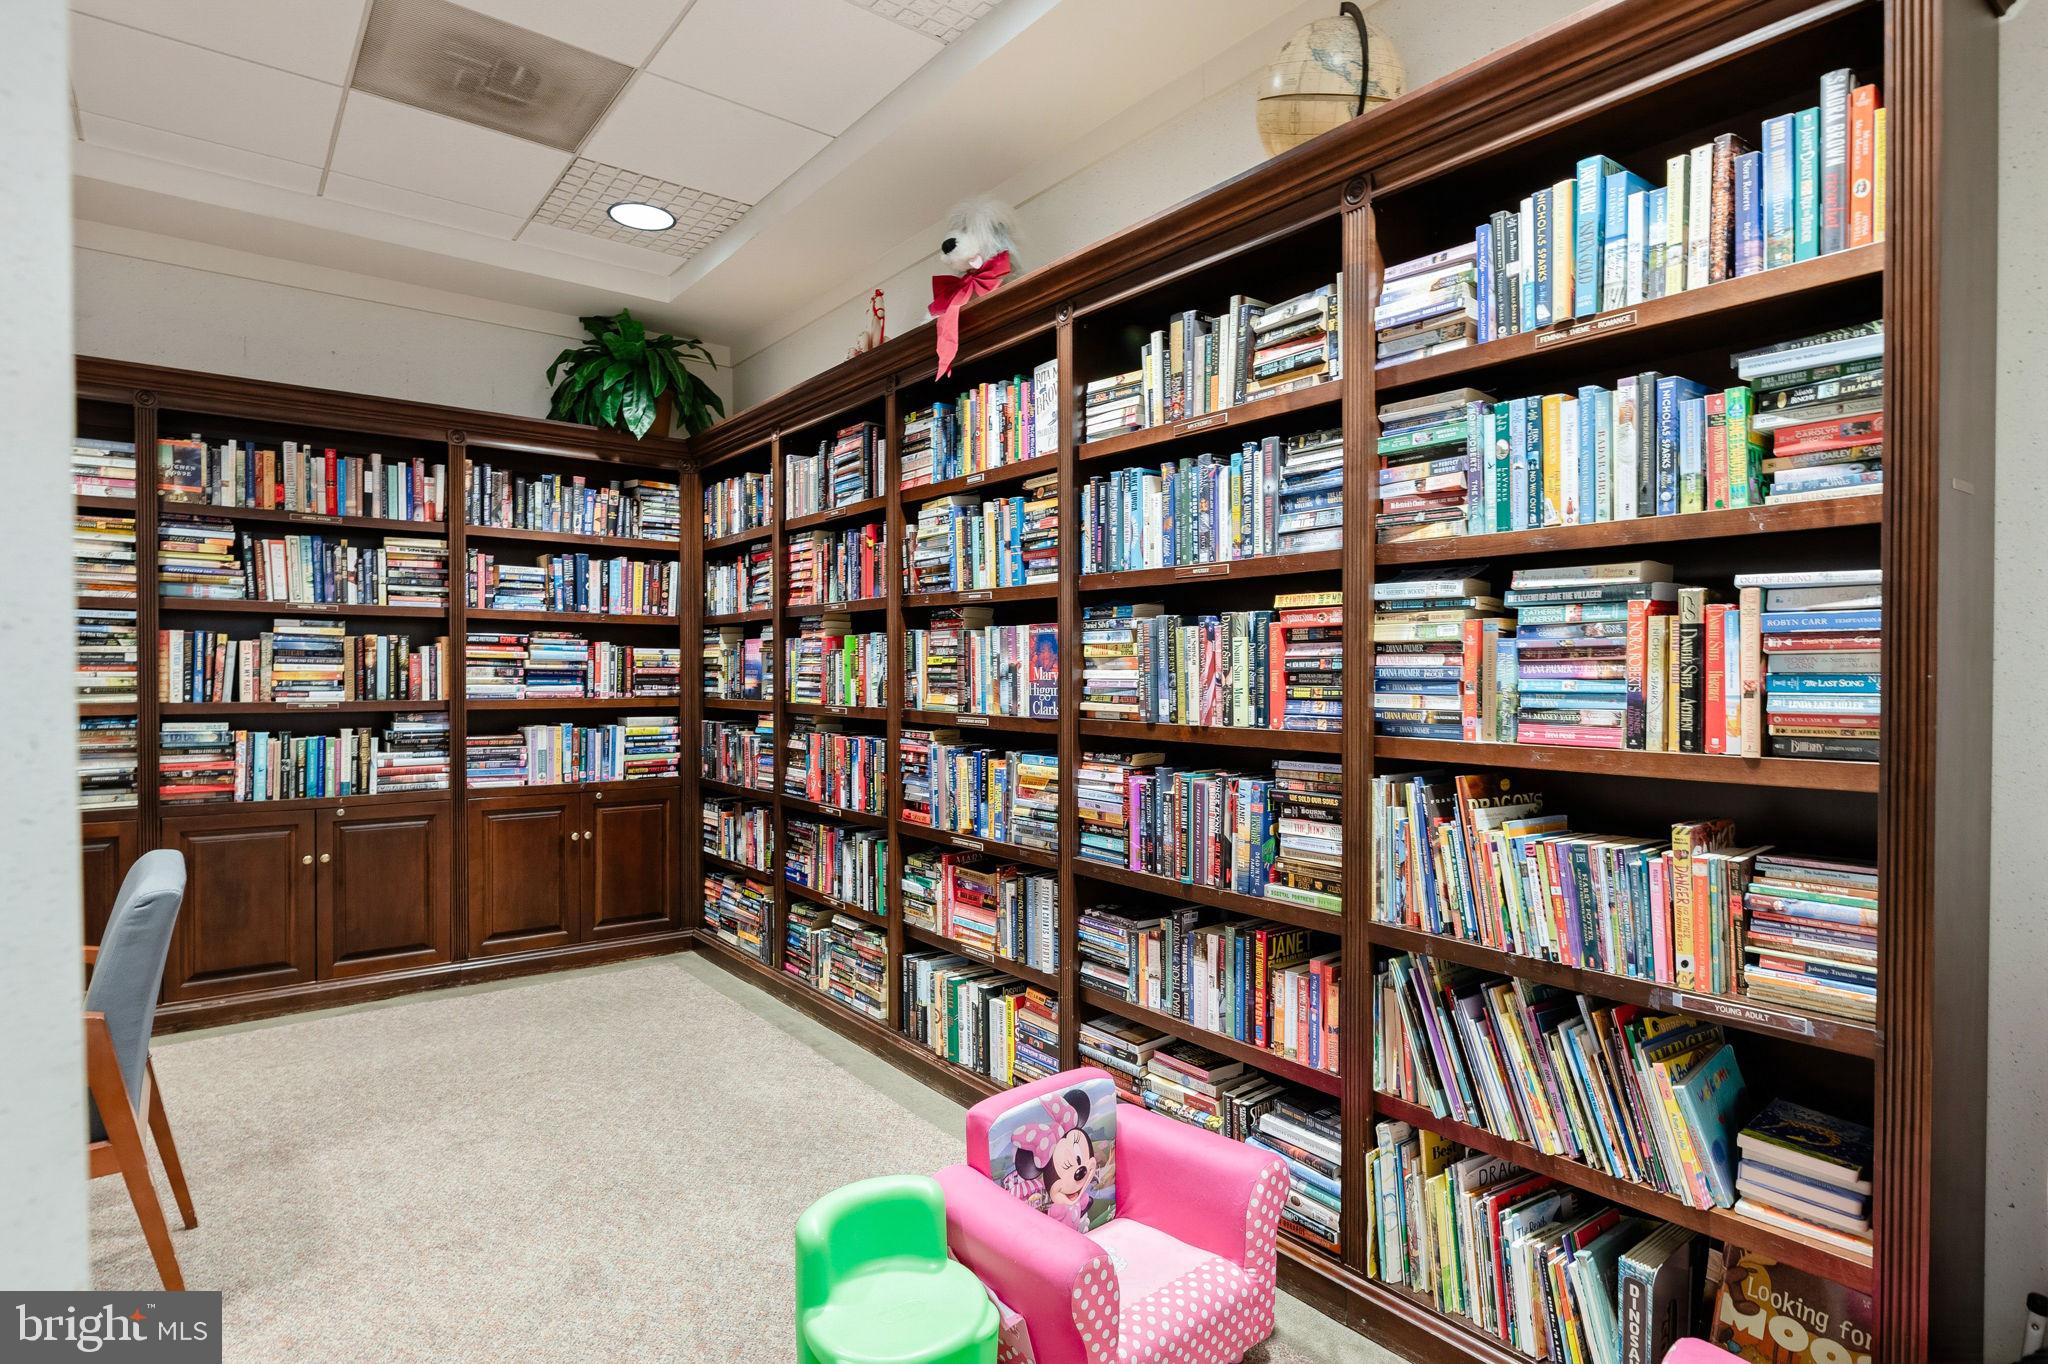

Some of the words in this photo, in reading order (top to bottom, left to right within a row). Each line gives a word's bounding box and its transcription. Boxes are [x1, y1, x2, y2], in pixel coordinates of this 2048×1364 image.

[1826, 75, 1845, 122] SANDRA
[1770, 121, 1788, 147] NORA
[1826, 124, 1845, 167] BROWN
[1743, 160, 1751, 179] Nora
[1743, 181, 1752, 210] Roberts
[1826, 173, 1845, 228] ricochet
[1536, 193, 1547, 246] NICHOLAS
[1772, 194, 1787, 237] HIDEAWAY
[1538, 249, 1547, 282] SPARKS
[1578, 253, 1594, 284] GOLD
[1598, 315, 1632, 328] ROMANCE
[1830, 332, 1851, 342] SEE
[1852, 328, 1866, 337] US
[1036, 372, 1050, 390] RITA
[1841, 383, 1869, 393] LILAC
[1662, 390, 1671, 435] NICHOLAS
[1795, 426, 1839, 439] CAROLYN
[1244, 448, 1252, 461] TONY
[1598, 432, 1606, 468] RADAR
[1661, 439, 1670, 468] SPARKS
[1821, 450, 1850, 460] DAILEY
[1244, 463, 1252, 495] HILLERMAN
[1530, 471, 1536, 482] NO
[1598, 472, 1606, 505] GIRLS
[1539, 592, 1546, 600] OF
[1547, 592, 1561, 600] DAVE
[1562, 591, 1573, 600] THE
[1574, 591, 1602, 599] VILLAGER
[1523, 615, 1564, 623] ANDERSON
[1708, 608, 1723, 641] DANIELLE
[1222, 615, 1230, 649] DANIELLE
[1629, 621, 1642, 650] NORA
[1403, 644, 1423, 652] PALMER
[1652, 628, 1660, 673] NICHOLAS
[1680, 629, 1697, 665] DANIELLE
[1708, 642, 1724, 662] STEEL
[1034, 667, 1058, 681] Mary
[1222, 651, 1231, 672] STEEL
[1380, 669, 1398, 677] DIANA
[1400, 669, 1420, 677] PALMER
[1628, 653, 1641, 692] ROBERTS
[1680, 665, 1697, 689] STEEL
[1032, 701, 1058, 715] Clark
[1385, 712, 1401, 720] DIANA
[1402, 712, 1421, 720] PALMER
[1681, 698, 1696, 732] ACCIDENT
[1834, 701, 1864, 709] MILLER
[1301, 808, 1326, 816] BOURNE
[1312, 796, 1321, 804] OUR
[1323, 798, 1338, 806] SOULS
[1271, 890, 1289, 898] DIGITAL
[1292, 893, 1314, 903] FORTRESS
[1582, 874, 1591, 906] HARRY
[1675, 865, 1690, 905] DANGER
[1271, 931, 1312, 960] JANET
[1807, 965, 1828, 976] Johnny
[1832, 969, 1858, 979] Tremain
[1715, 1004, 1742, 1016] YOUNG
[1745, 1010, 1769, 1022] ADULT
[1256, 1026, 1263, 1040] UP
[1551, 1092, 1561, 1113] STORIES
[1629, 1284, 1640, 1364] DINOSA
[1747, 1276, 1829, 1332] Looking
[1839, 1323, 1872, 1350] for
[1720, 1292, 1872, 1364] MOO
